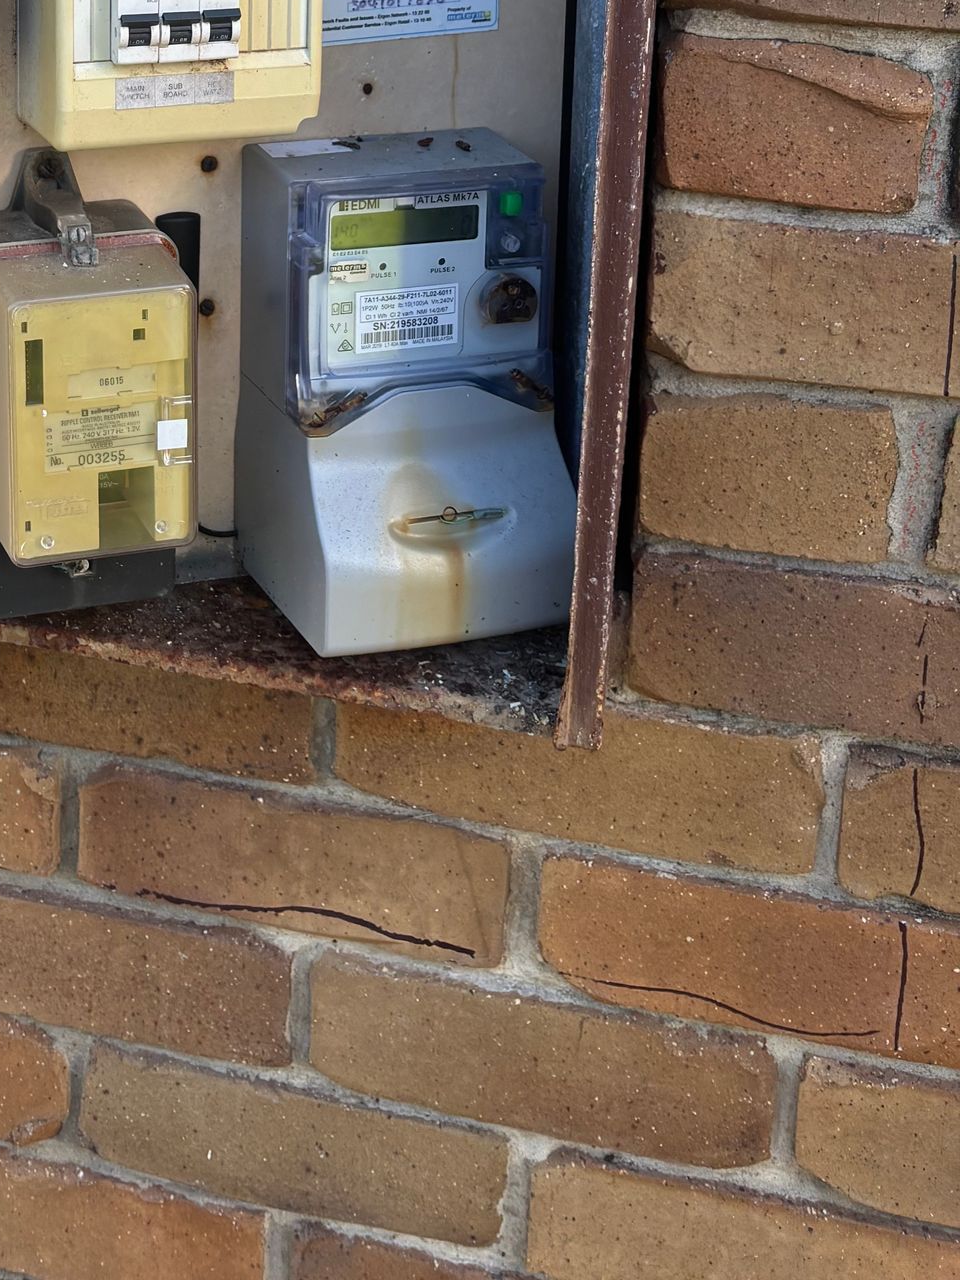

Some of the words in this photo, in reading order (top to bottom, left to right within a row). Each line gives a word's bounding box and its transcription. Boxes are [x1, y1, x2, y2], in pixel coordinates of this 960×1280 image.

[168, 82, 183, 90] SUB
[417, 193, 450, 204] ATLAS
[453, 192, 479, 202] Mk7A
[351, 199, 380, 211] EDMI
[373, 316, 439, 331] SN:219583208
[99, 376, 124, 387] 06015
[78, 450, 126, 466] 003255
